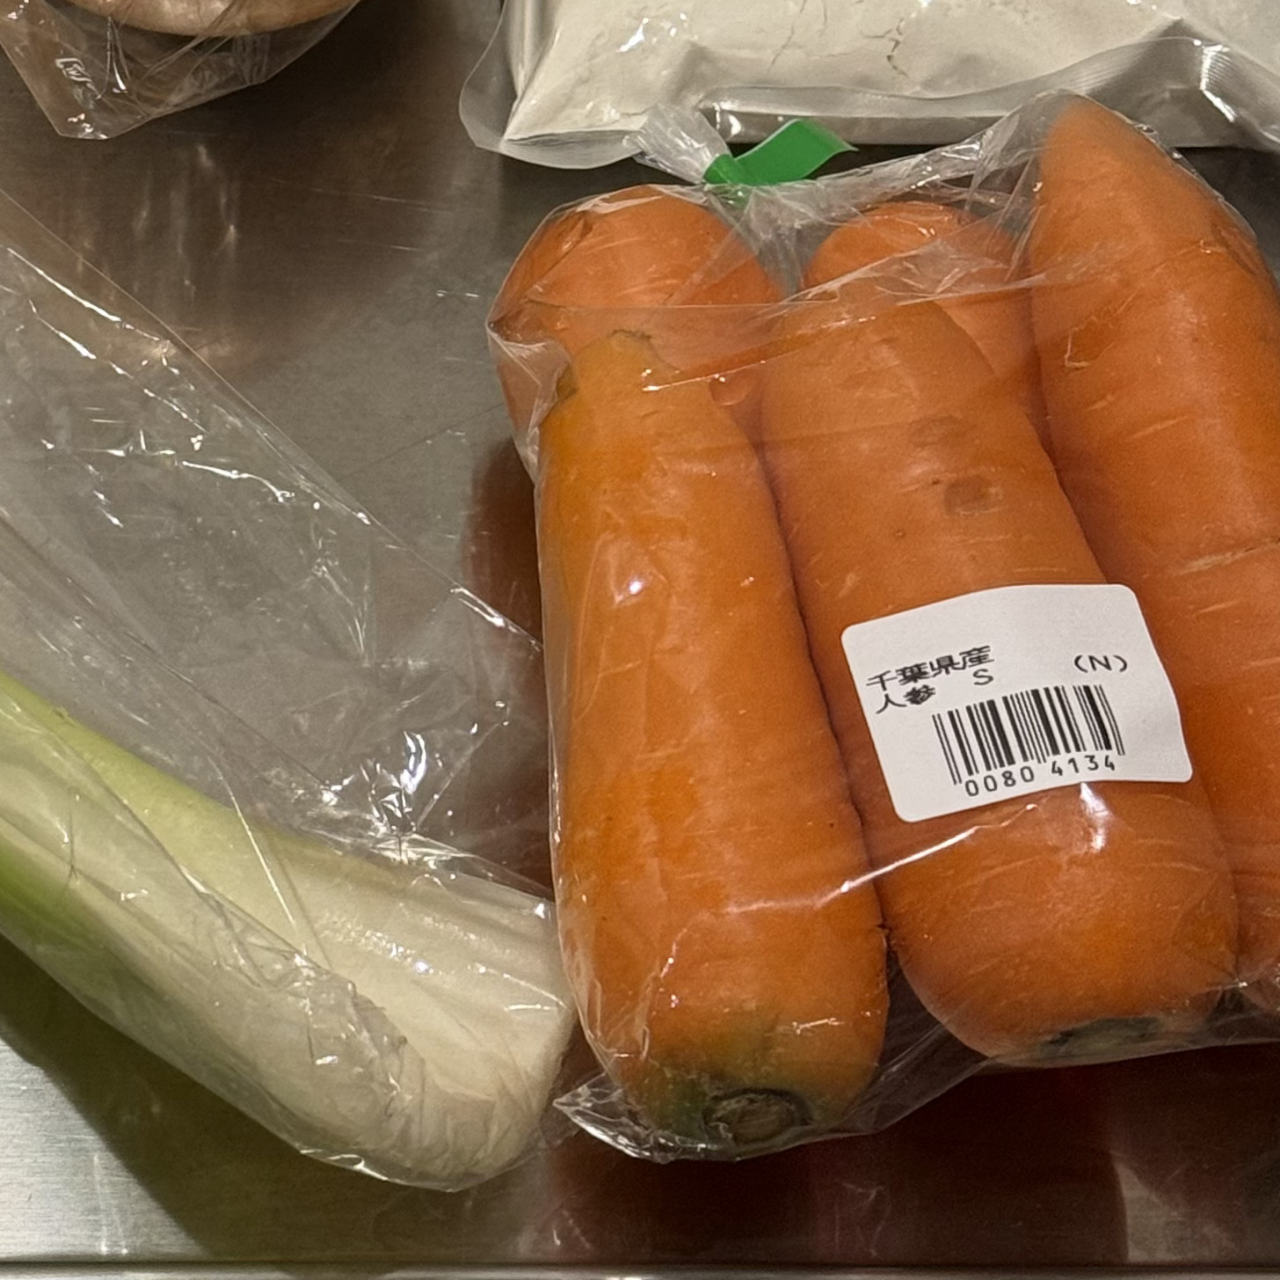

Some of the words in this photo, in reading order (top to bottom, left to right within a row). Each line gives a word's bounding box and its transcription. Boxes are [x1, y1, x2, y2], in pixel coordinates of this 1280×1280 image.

[865, 645, 995, 692] 千葉県産
[972, 668, 995, 687] S
[1073, 654, 1129, 673] (N)
[964, 765, 1035, 797] 0080
[1051, 754, 1116, 777] 4134
